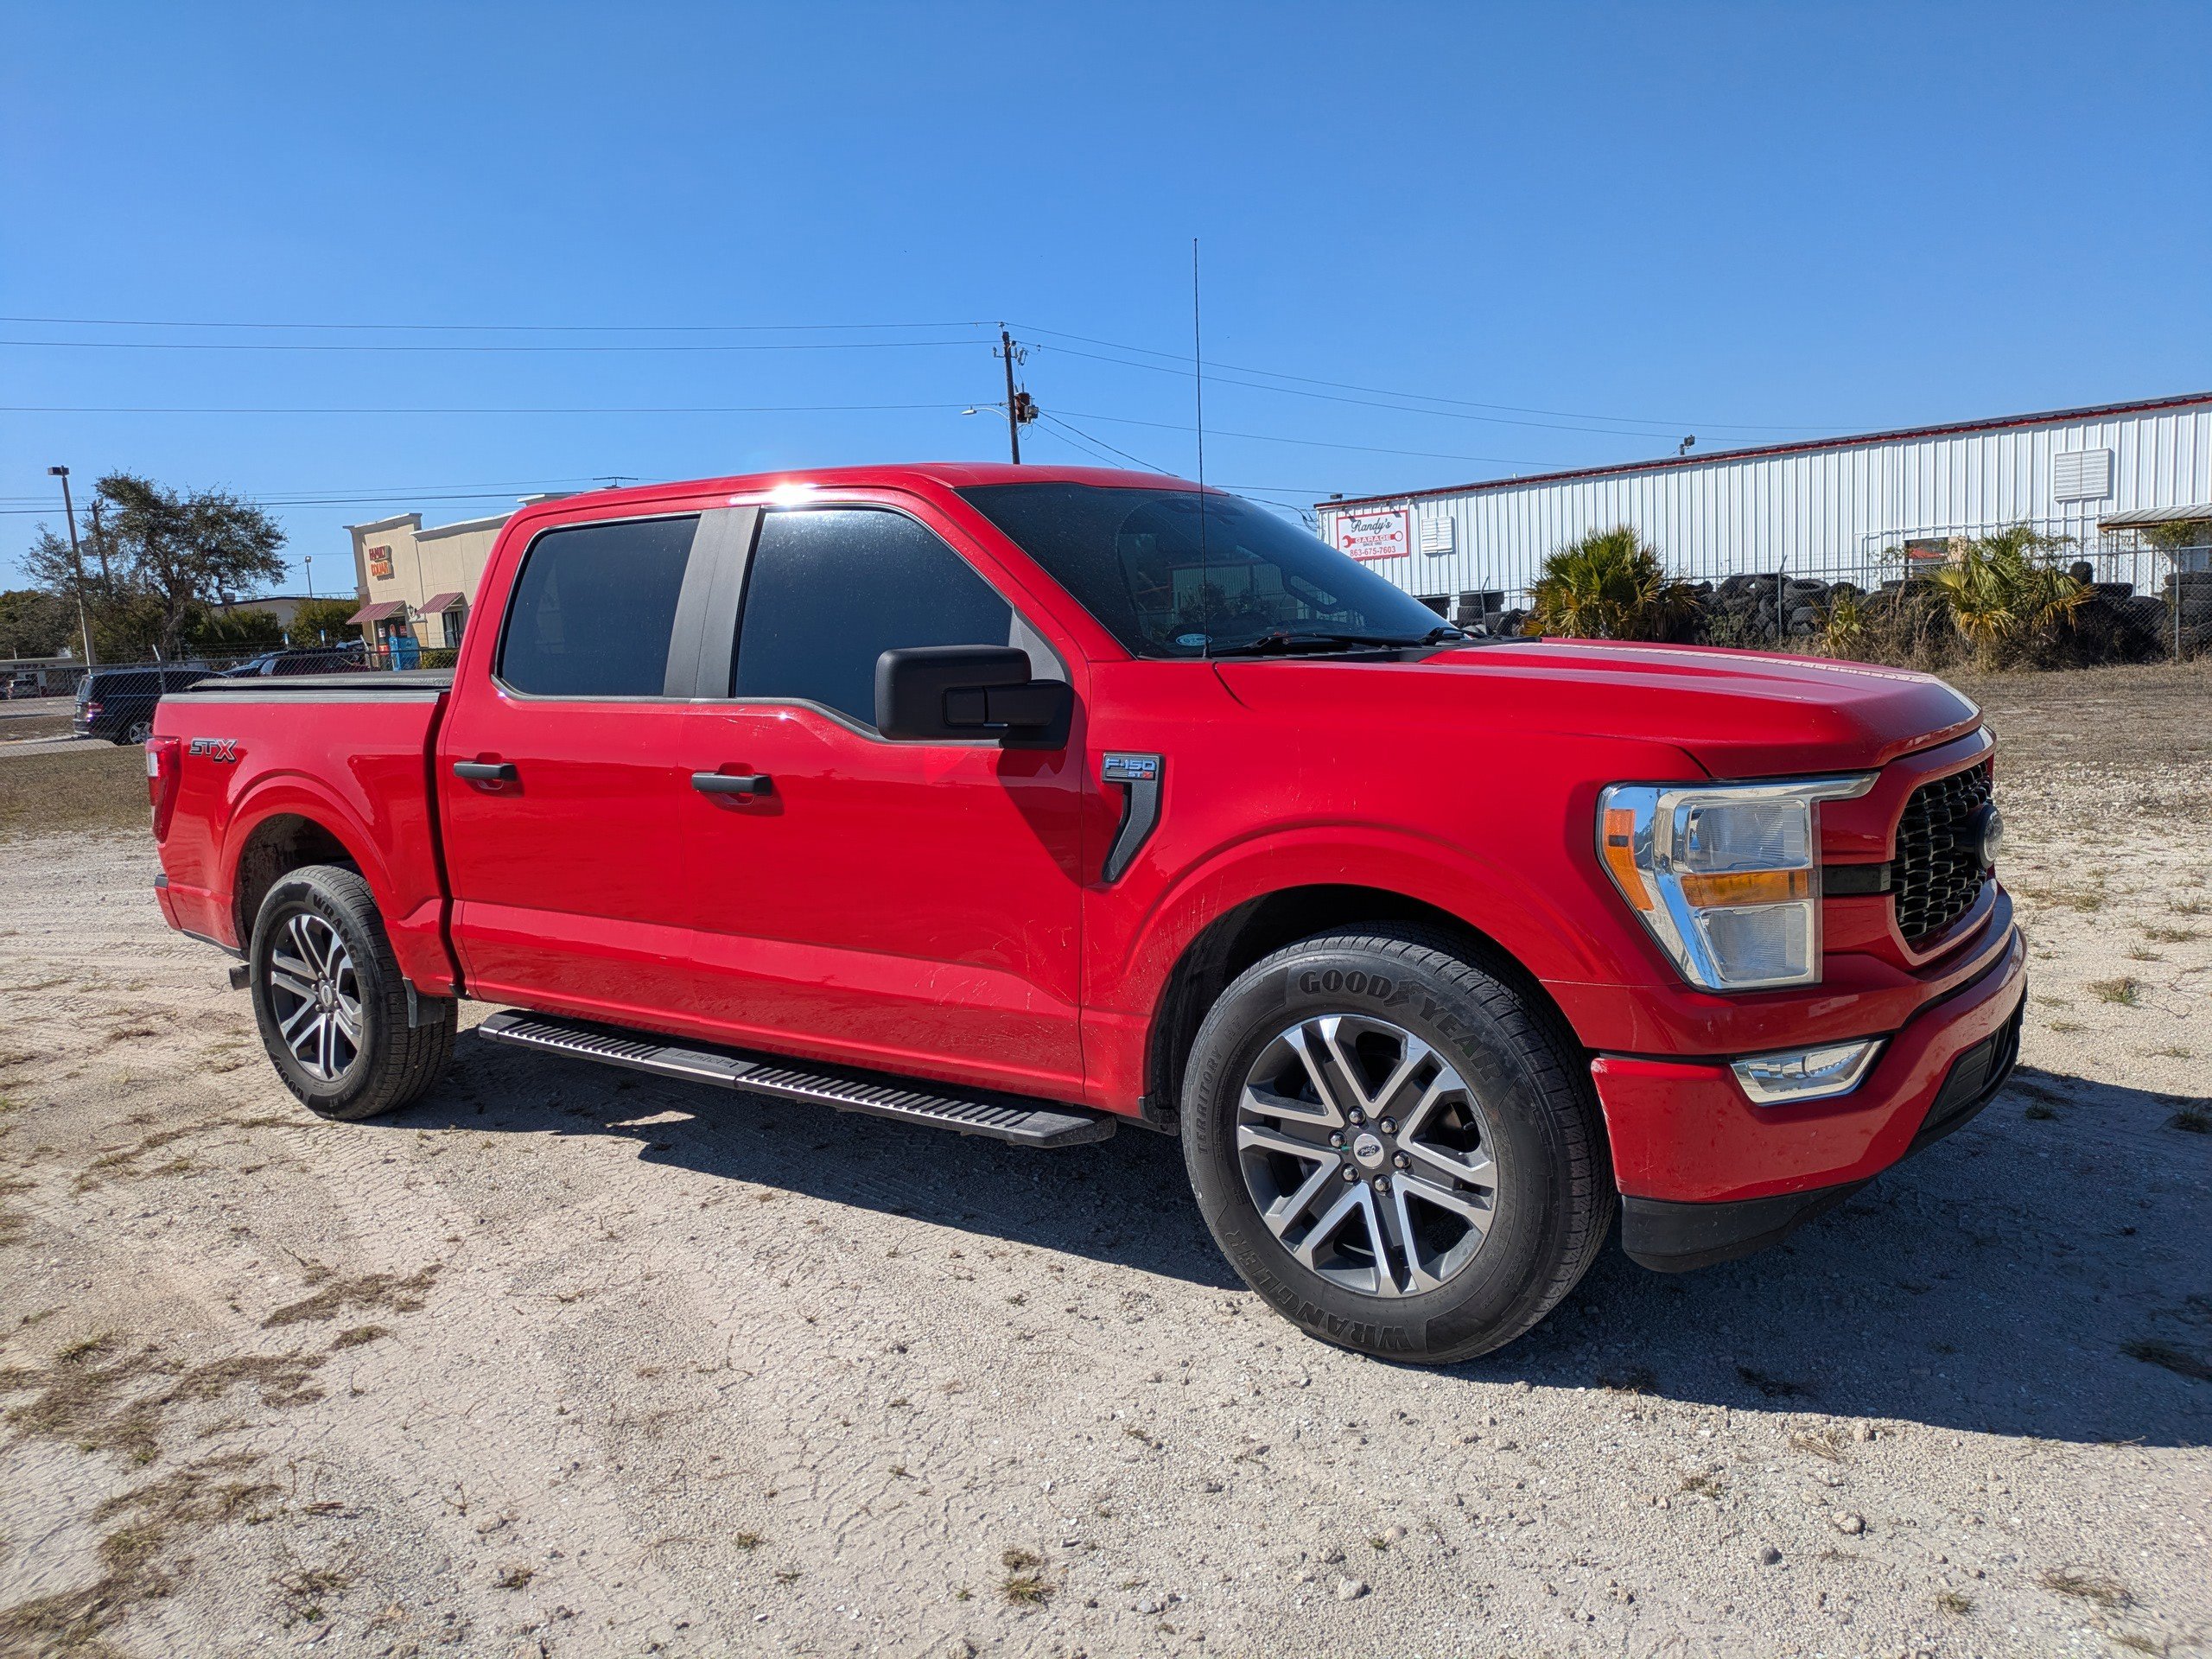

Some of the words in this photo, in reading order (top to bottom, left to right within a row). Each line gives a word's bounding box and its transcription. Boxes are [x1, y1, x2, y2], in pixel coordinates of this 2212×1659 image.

[1351, 518, 1393, 535] Randy's
[1355, 534, 1391, 543] GARAGE
[369, 545, 386, 561] FAMILY
[1350, 545, 1396, 557] 863-675-7603
[371, 561, 390, 576] DOLLAR
[188, 737, 238, 763] STX
[1105, 757, 1157, 772] F-150
[1196, 1044, 1224, 1155] TERRITORY
[1224, 1015, 1244, 1042] HT
[1360, 1146, 1376, 1156] Ford
[1224, 1230, 1414, 1351] WRANGLER
